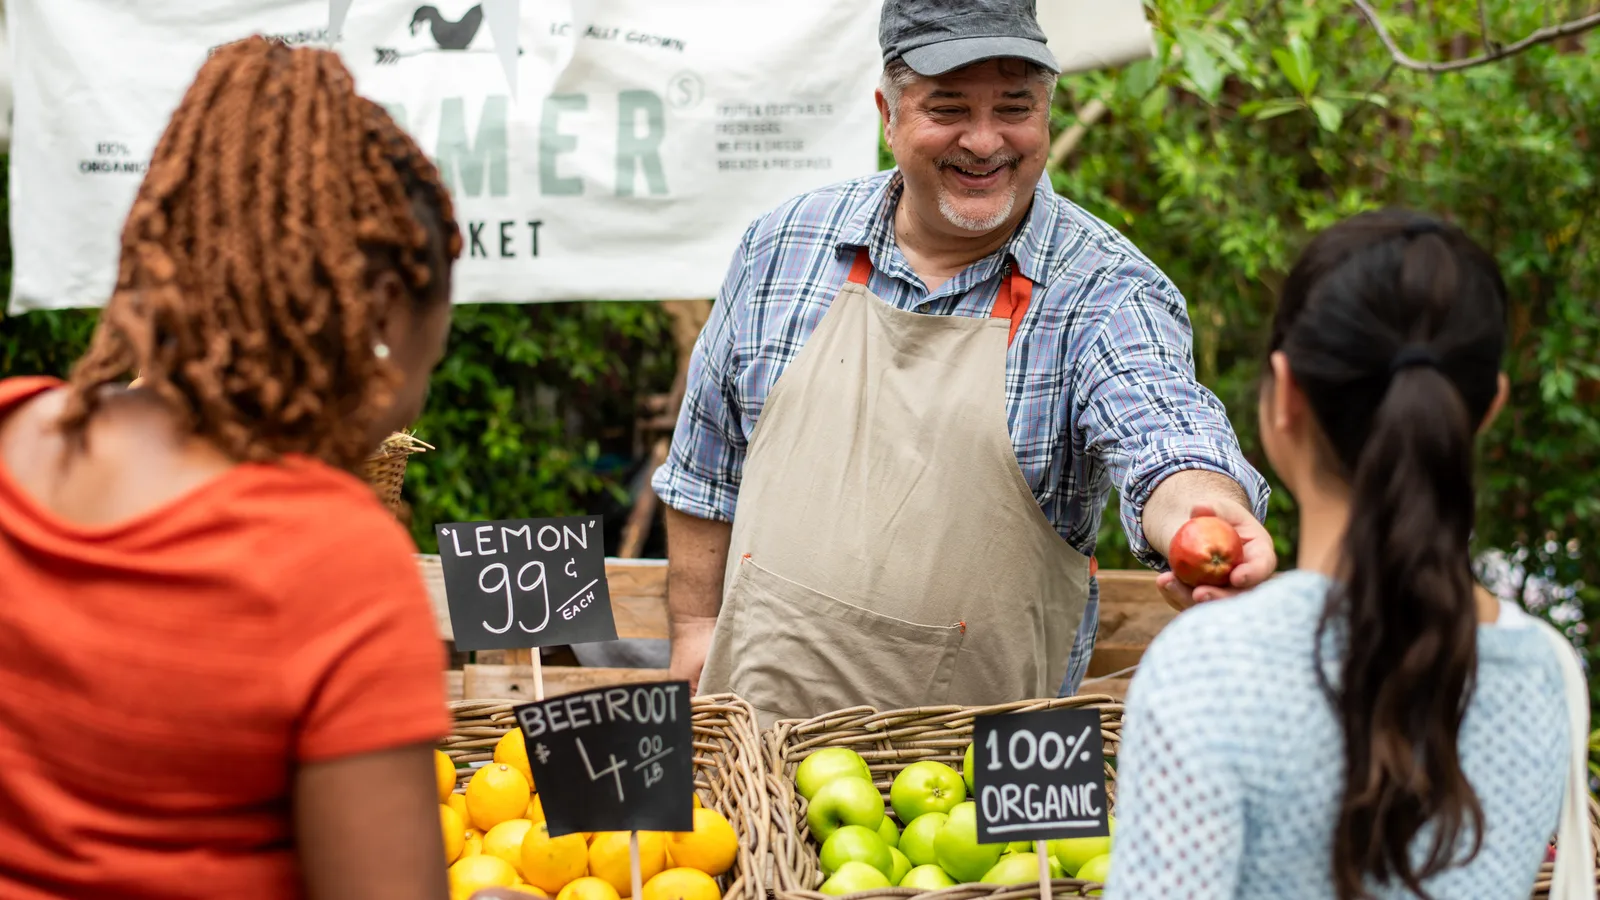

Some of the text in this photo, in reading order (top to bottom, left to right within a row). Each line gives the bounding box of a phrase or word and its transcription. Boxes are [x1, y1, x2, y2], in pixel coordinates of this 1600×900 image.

[388, 88, 669, 198] MER
[478, 560, 550, 634] 99
[562, 591, 595, 620] EACH
[517, 685, 680, 738] BEETROOT
[534, 735, 663, 802] $ 4 00
[985, 725, 1092, 771] 100%
[643, 762, 664, 788] LB
[981, 781, 1101, 823] ORGANIC
